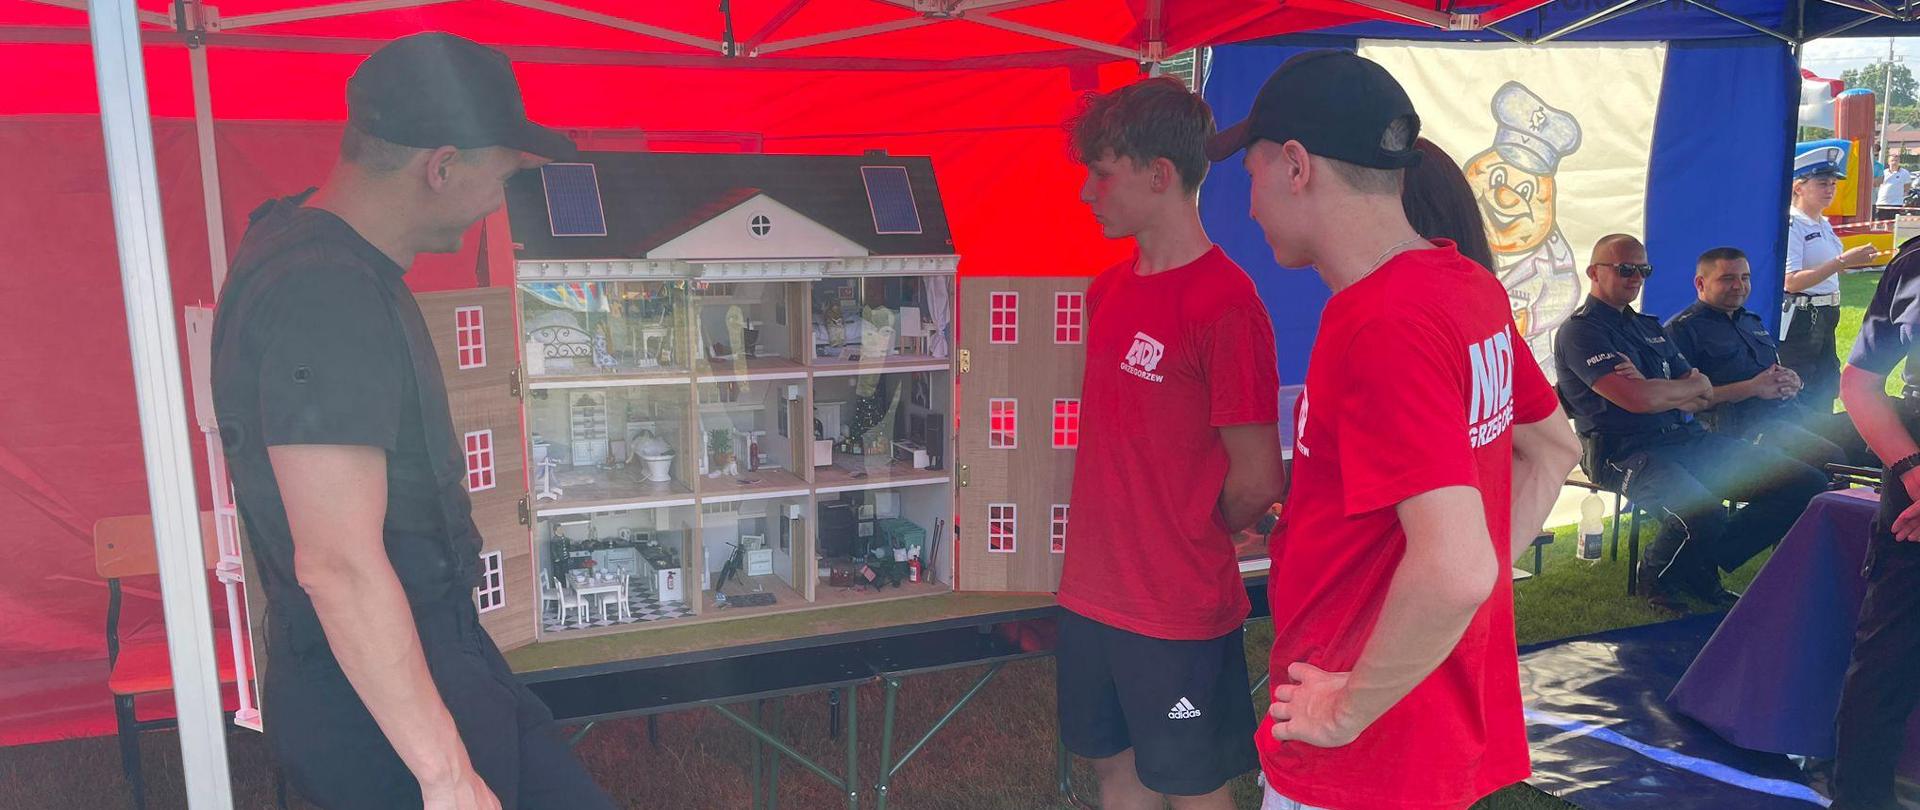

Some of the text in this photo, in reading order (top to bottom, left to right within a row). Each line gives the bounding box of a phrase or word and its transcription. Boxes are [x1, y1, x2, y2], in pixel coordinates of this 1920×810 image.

[1120, 362, 1164, 383] GRZEGORZEW
[1469, 324, 1514, 425] MD
[1168, 709, 1201, 719] adidas
